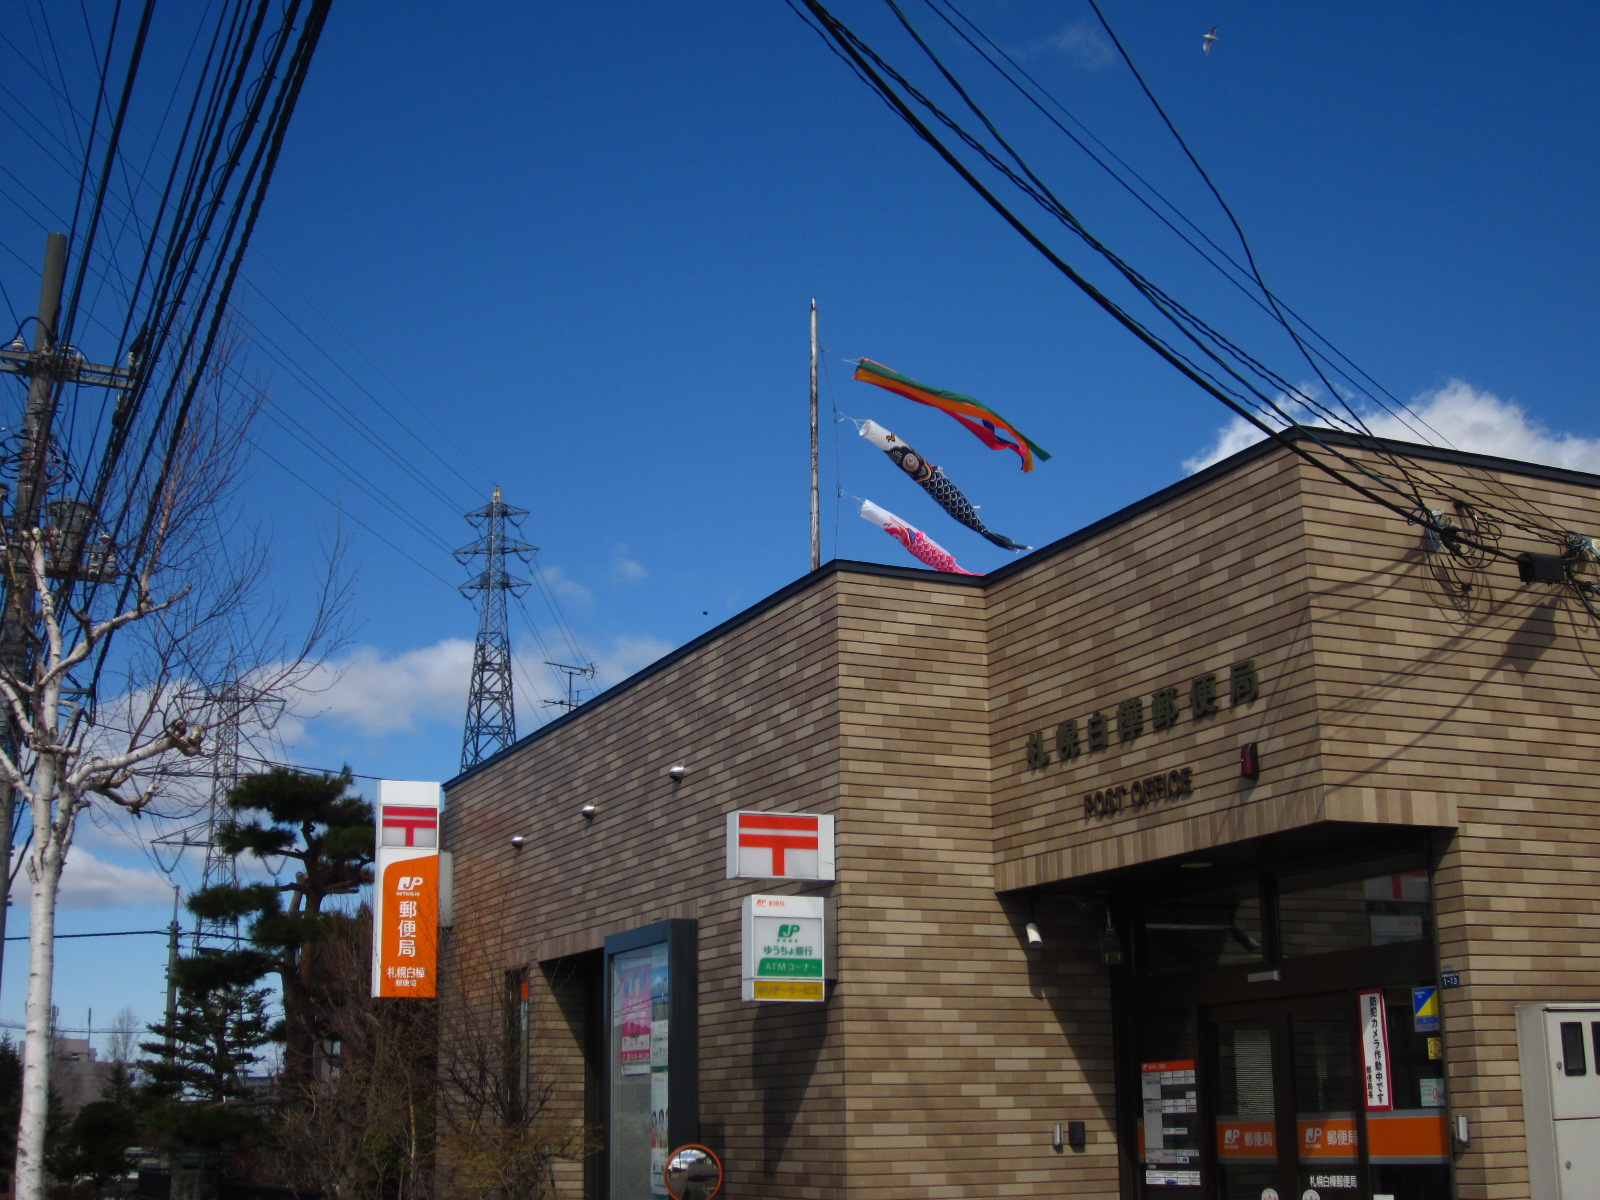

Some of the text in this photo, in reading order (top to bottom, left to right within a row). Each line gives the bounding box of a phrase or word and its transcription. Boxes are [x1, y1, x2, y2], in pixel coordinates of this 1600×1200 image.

[1025, 659, 1259, 770] 札幌白樺郵便局
[1084, 767, 1194, 819] POST OFFICE
[397, 877, 423, 890] JP
[397, 900, 417, 958] 郵便局
[778, 924, 800, 938] JP
[763, 945, 813, 956] ゆうちょ銀行
[387, 966, 425, 979] 札幌白樺
[765, 963, 817, 972] ATMコーナー
[1443, 977, 1458, 986] 1-13
[1369, 996, 1384, 1104] 防犯カメラ作動中です
[1366, 1066, 1374, 1099] 郵便局長
[1224, 1129, 1240, 1144] JP
[1244, 1132, 1273, 1147] 郵便局
[1305, 1127, 1322, 1143] JP
[1326, 1130, 1358, 1146] 郵便局
[1309, 1175, 1358, 1188] 札幌白樺郵便局
